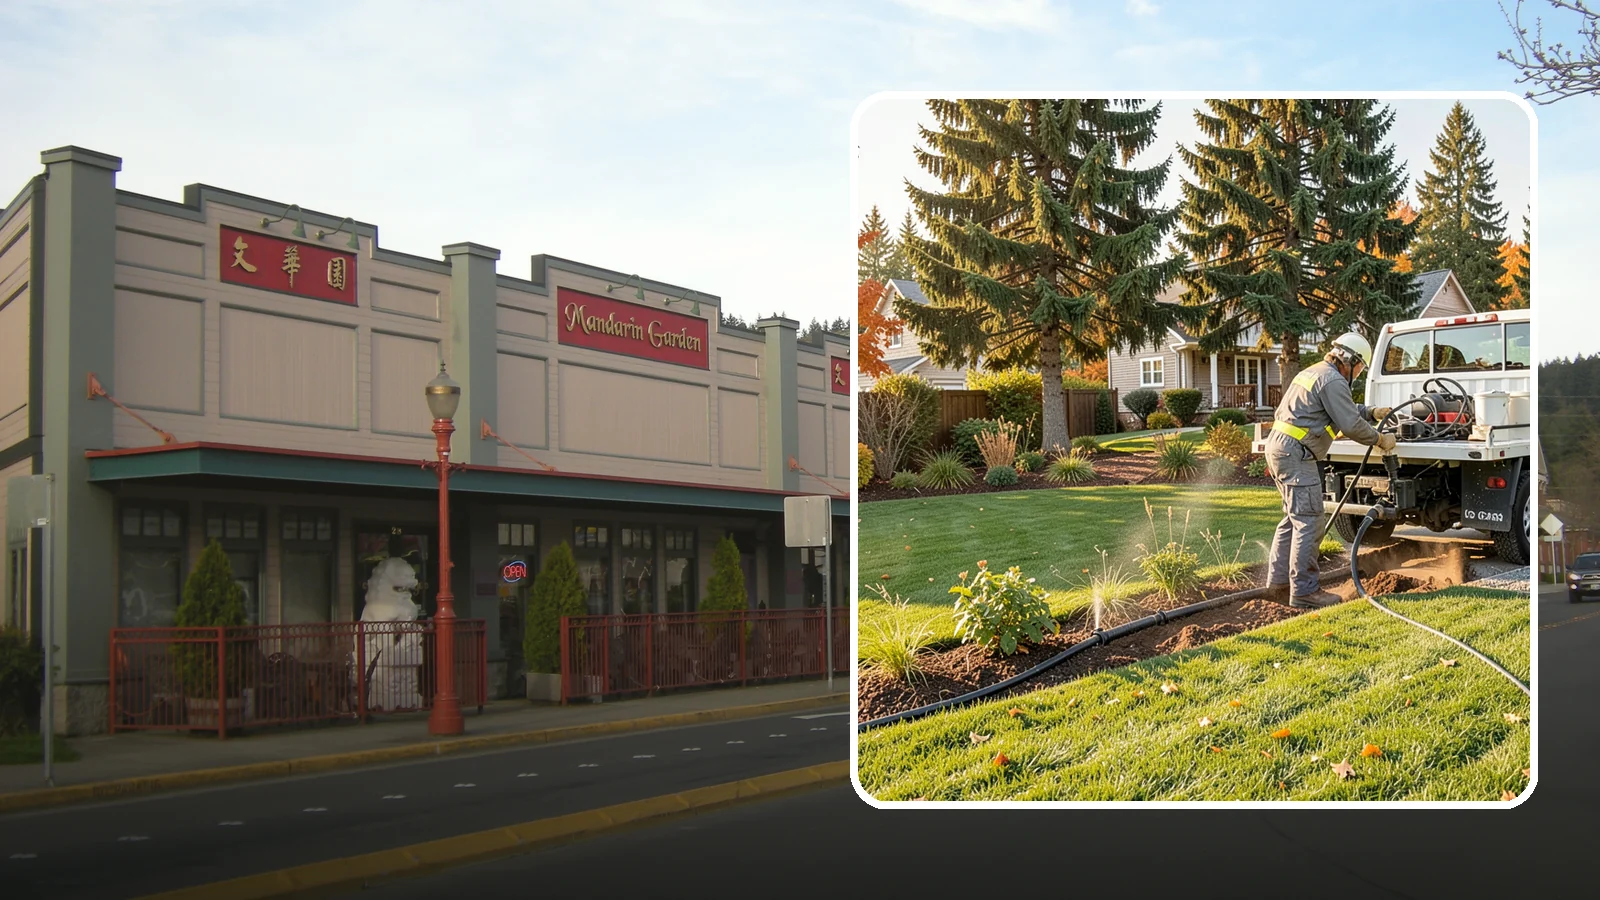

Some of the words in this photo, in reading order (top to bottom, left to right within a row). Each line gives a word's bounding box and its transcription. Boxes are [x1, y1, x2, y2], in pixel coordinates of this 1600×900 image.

[230, 235, 347, 291] 文華園
[564, 302, 644, 341] Mandarin
[647, 320, 702, 352] Garden
[503, 565, 527, 578] OPEN
